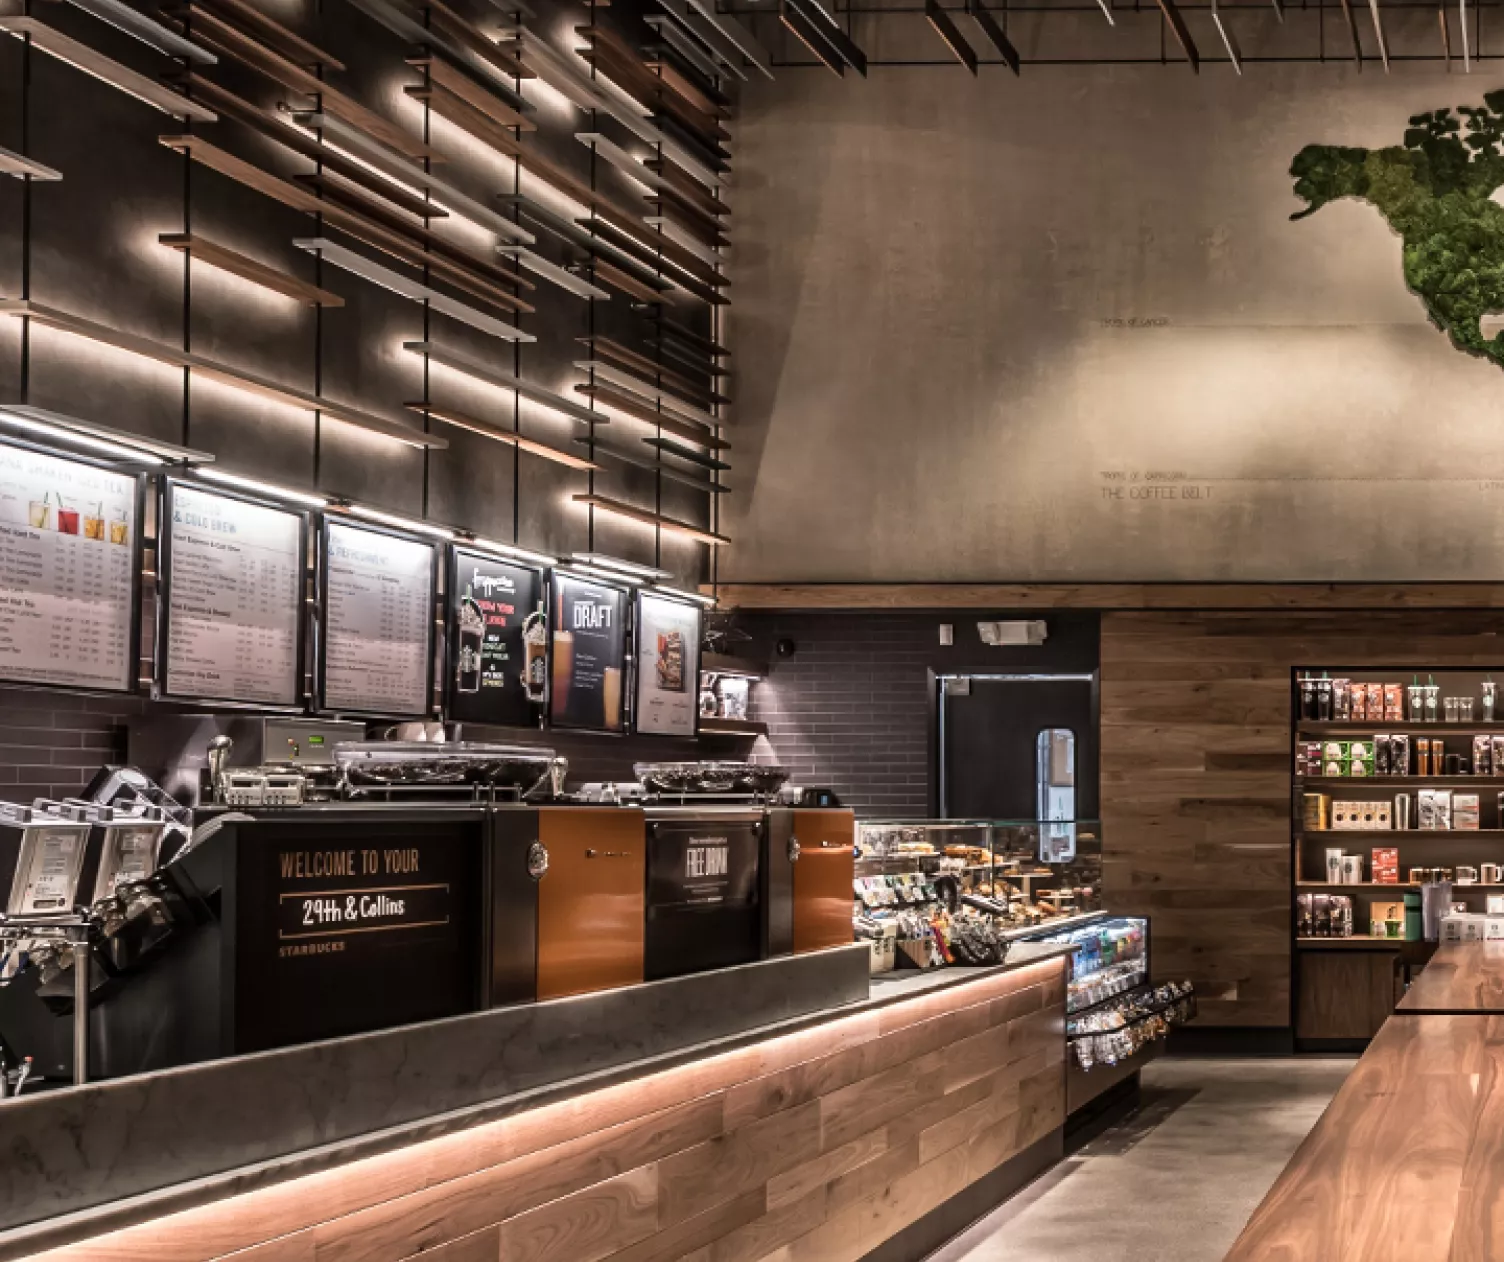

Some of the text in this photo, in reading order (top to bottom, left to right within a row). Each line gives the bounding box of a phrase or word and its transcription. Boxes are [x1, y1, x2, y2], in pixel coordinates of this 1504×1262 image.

[1101, 485, 1214, 500] THE COFFEE BELT
[573, 605, 612, 628] DRAFT
[279, 847, 420, 879] WELCOME TO YOUR
[302, 893, 406, 926] 29th & Collins
[278, 940, 346, 958] STARBUCKS
